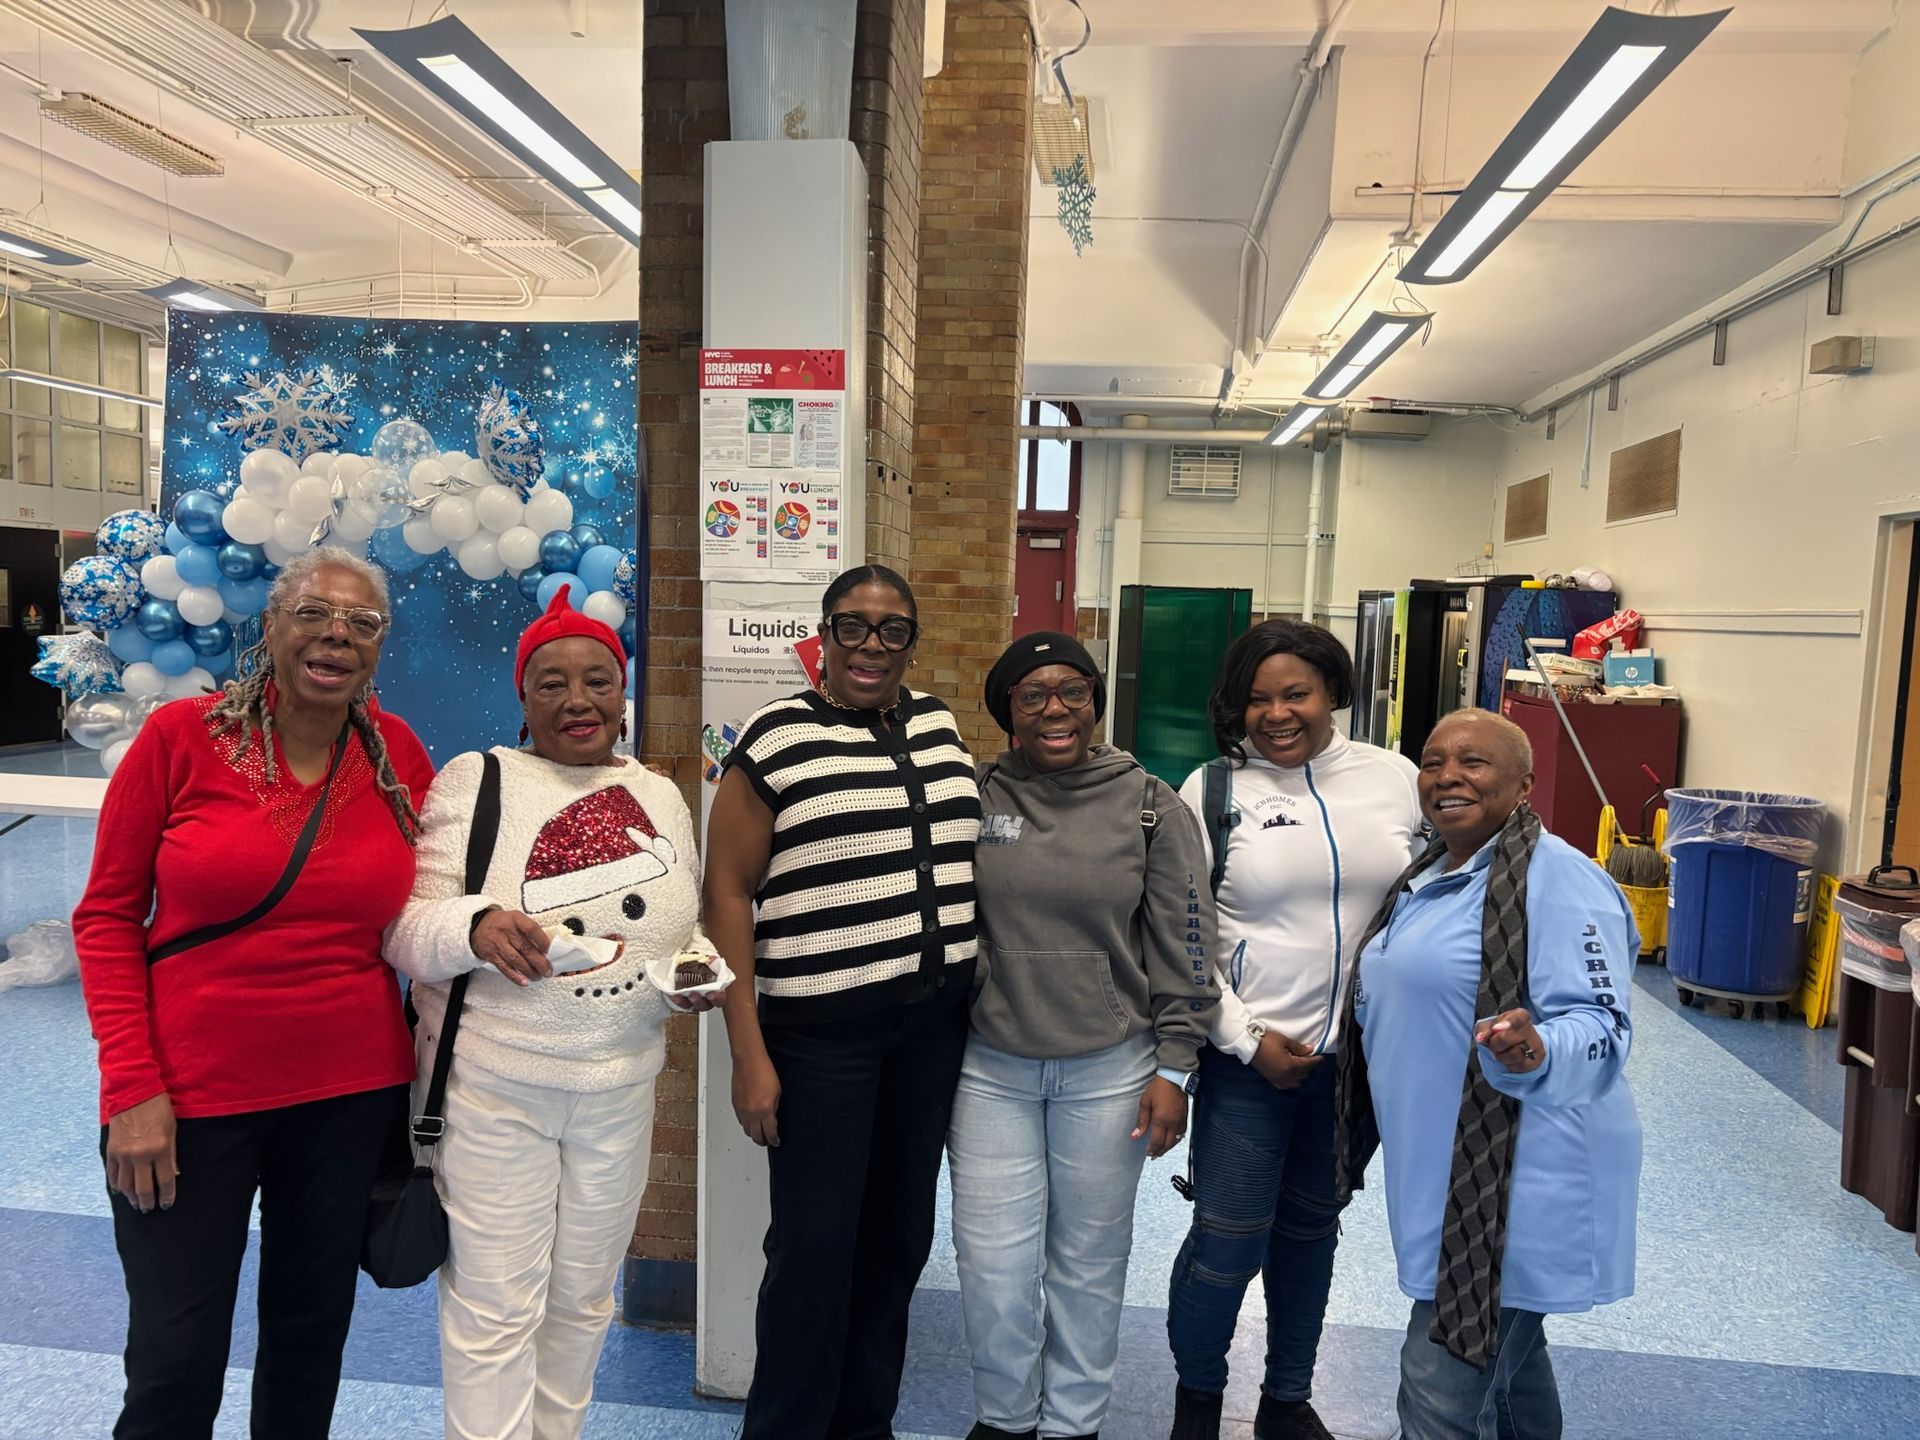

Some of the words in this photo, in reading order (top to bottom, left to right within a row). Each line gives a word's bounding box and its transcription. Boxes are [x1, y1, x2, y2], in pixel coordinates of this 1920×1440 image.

[705, 362, 763, 374] BREAKFAST
[764, 362, 773, 374] &
[705, 375, 737, 386] LUNCH
[710, 481, 740, 493] YOU
[780, 482, 810, 494] YOU
[729, 617, 808, 641] Liquids
[733, 644, 770, 655] Líquidos
[725, 667, 751, 675] recycle
[753, 668, 776, 676] empty
[1625, 666, 1639, 678] hp
